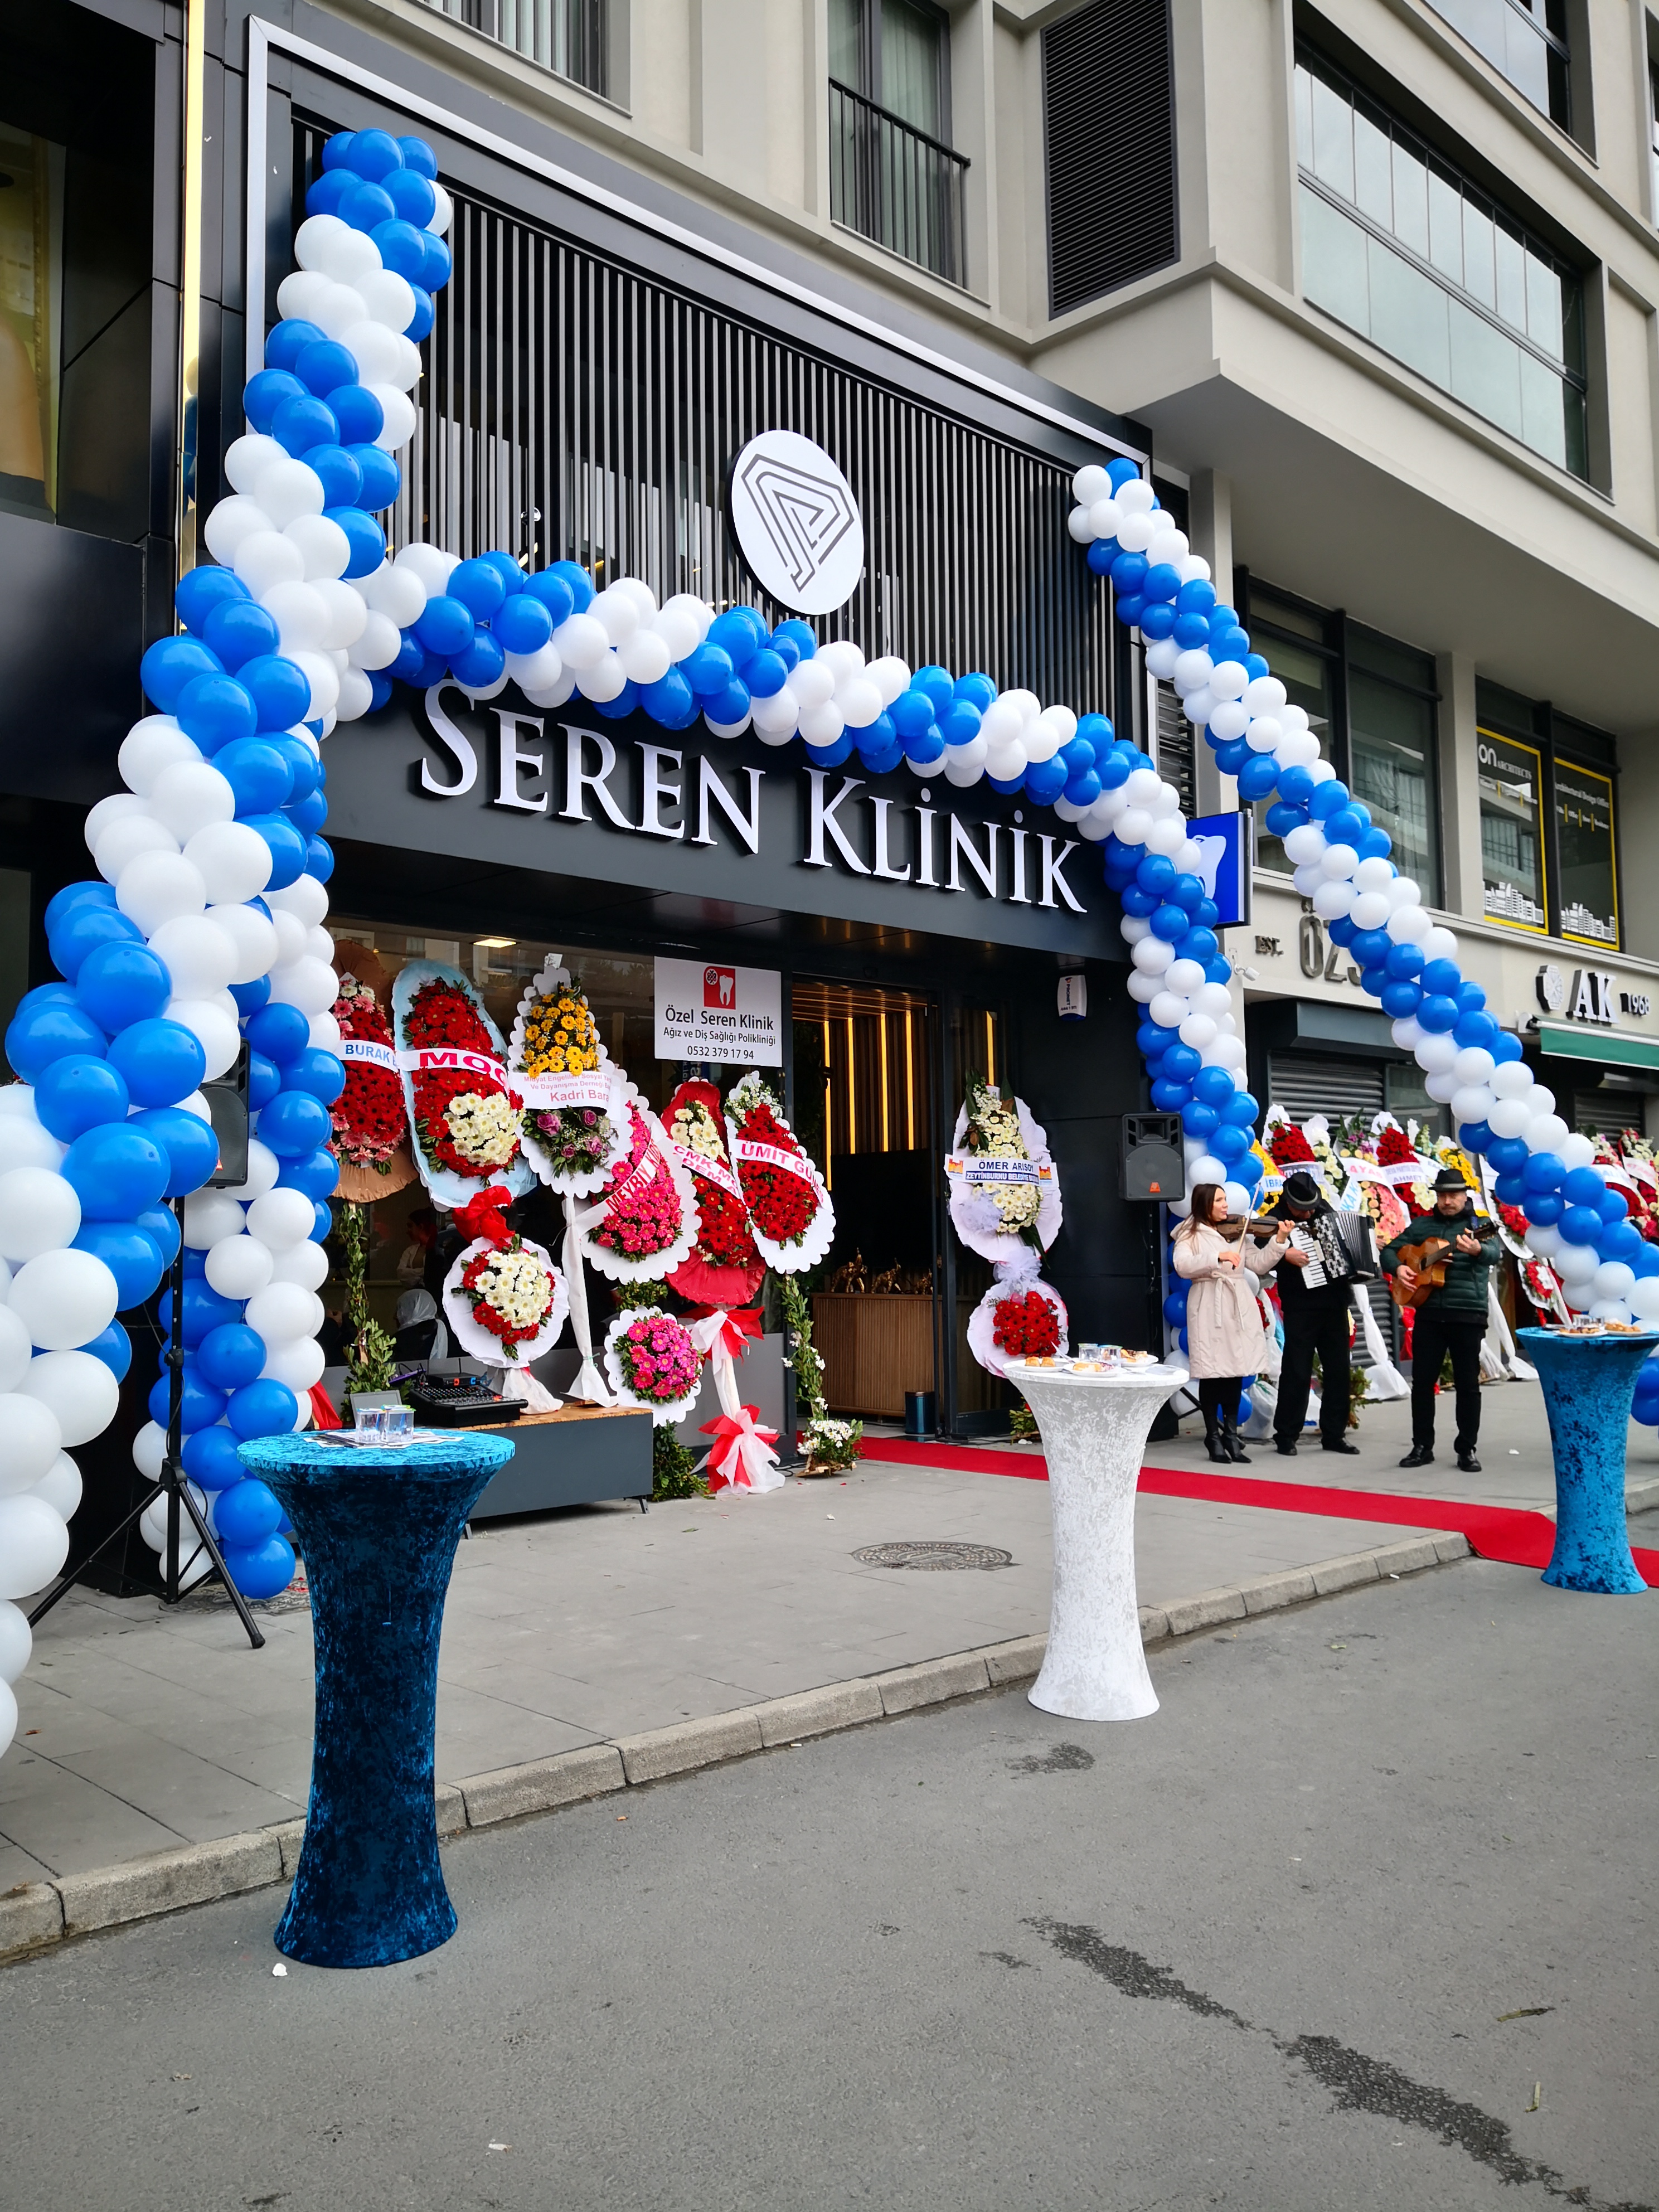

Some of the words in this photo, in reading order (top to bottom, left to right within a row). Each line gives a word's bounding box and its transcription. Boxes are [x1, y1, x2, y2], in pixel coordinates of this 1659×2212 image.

[421, 680, 766, 855] SEREN
[803, 767, 1088, 914] KLİNİK
[1569, 968, 1620, 1024] AK
[665, 1004, 694, 1023] Özel
[701, 1011, 736, 1027] Seren
[740, 1014, 774, 1030] Klinik
[663, 1027, 681, 1039] Ağız
[695, 1030, 707, 1041] Diş
[710, 1031, 736, 1043] Sağlığı
[738, 1033, 775, 1046] Polikliniği
[345, 1044, 391, 1063] BURAK
[687, 1045, 710, 1056] 0532
[712, 1047, 728, 1058] 379
[731, 1049, 740, 1058] 17
[743, 1050, 754, 1059] 94
[541, 1082, 578, 1090] Dayanışma
[550, 1089, 584, 1102] Kadri
[741, 1141, 789, 1165] ÜMİT
[978, 1160, 1008, 1170] ÖMER
